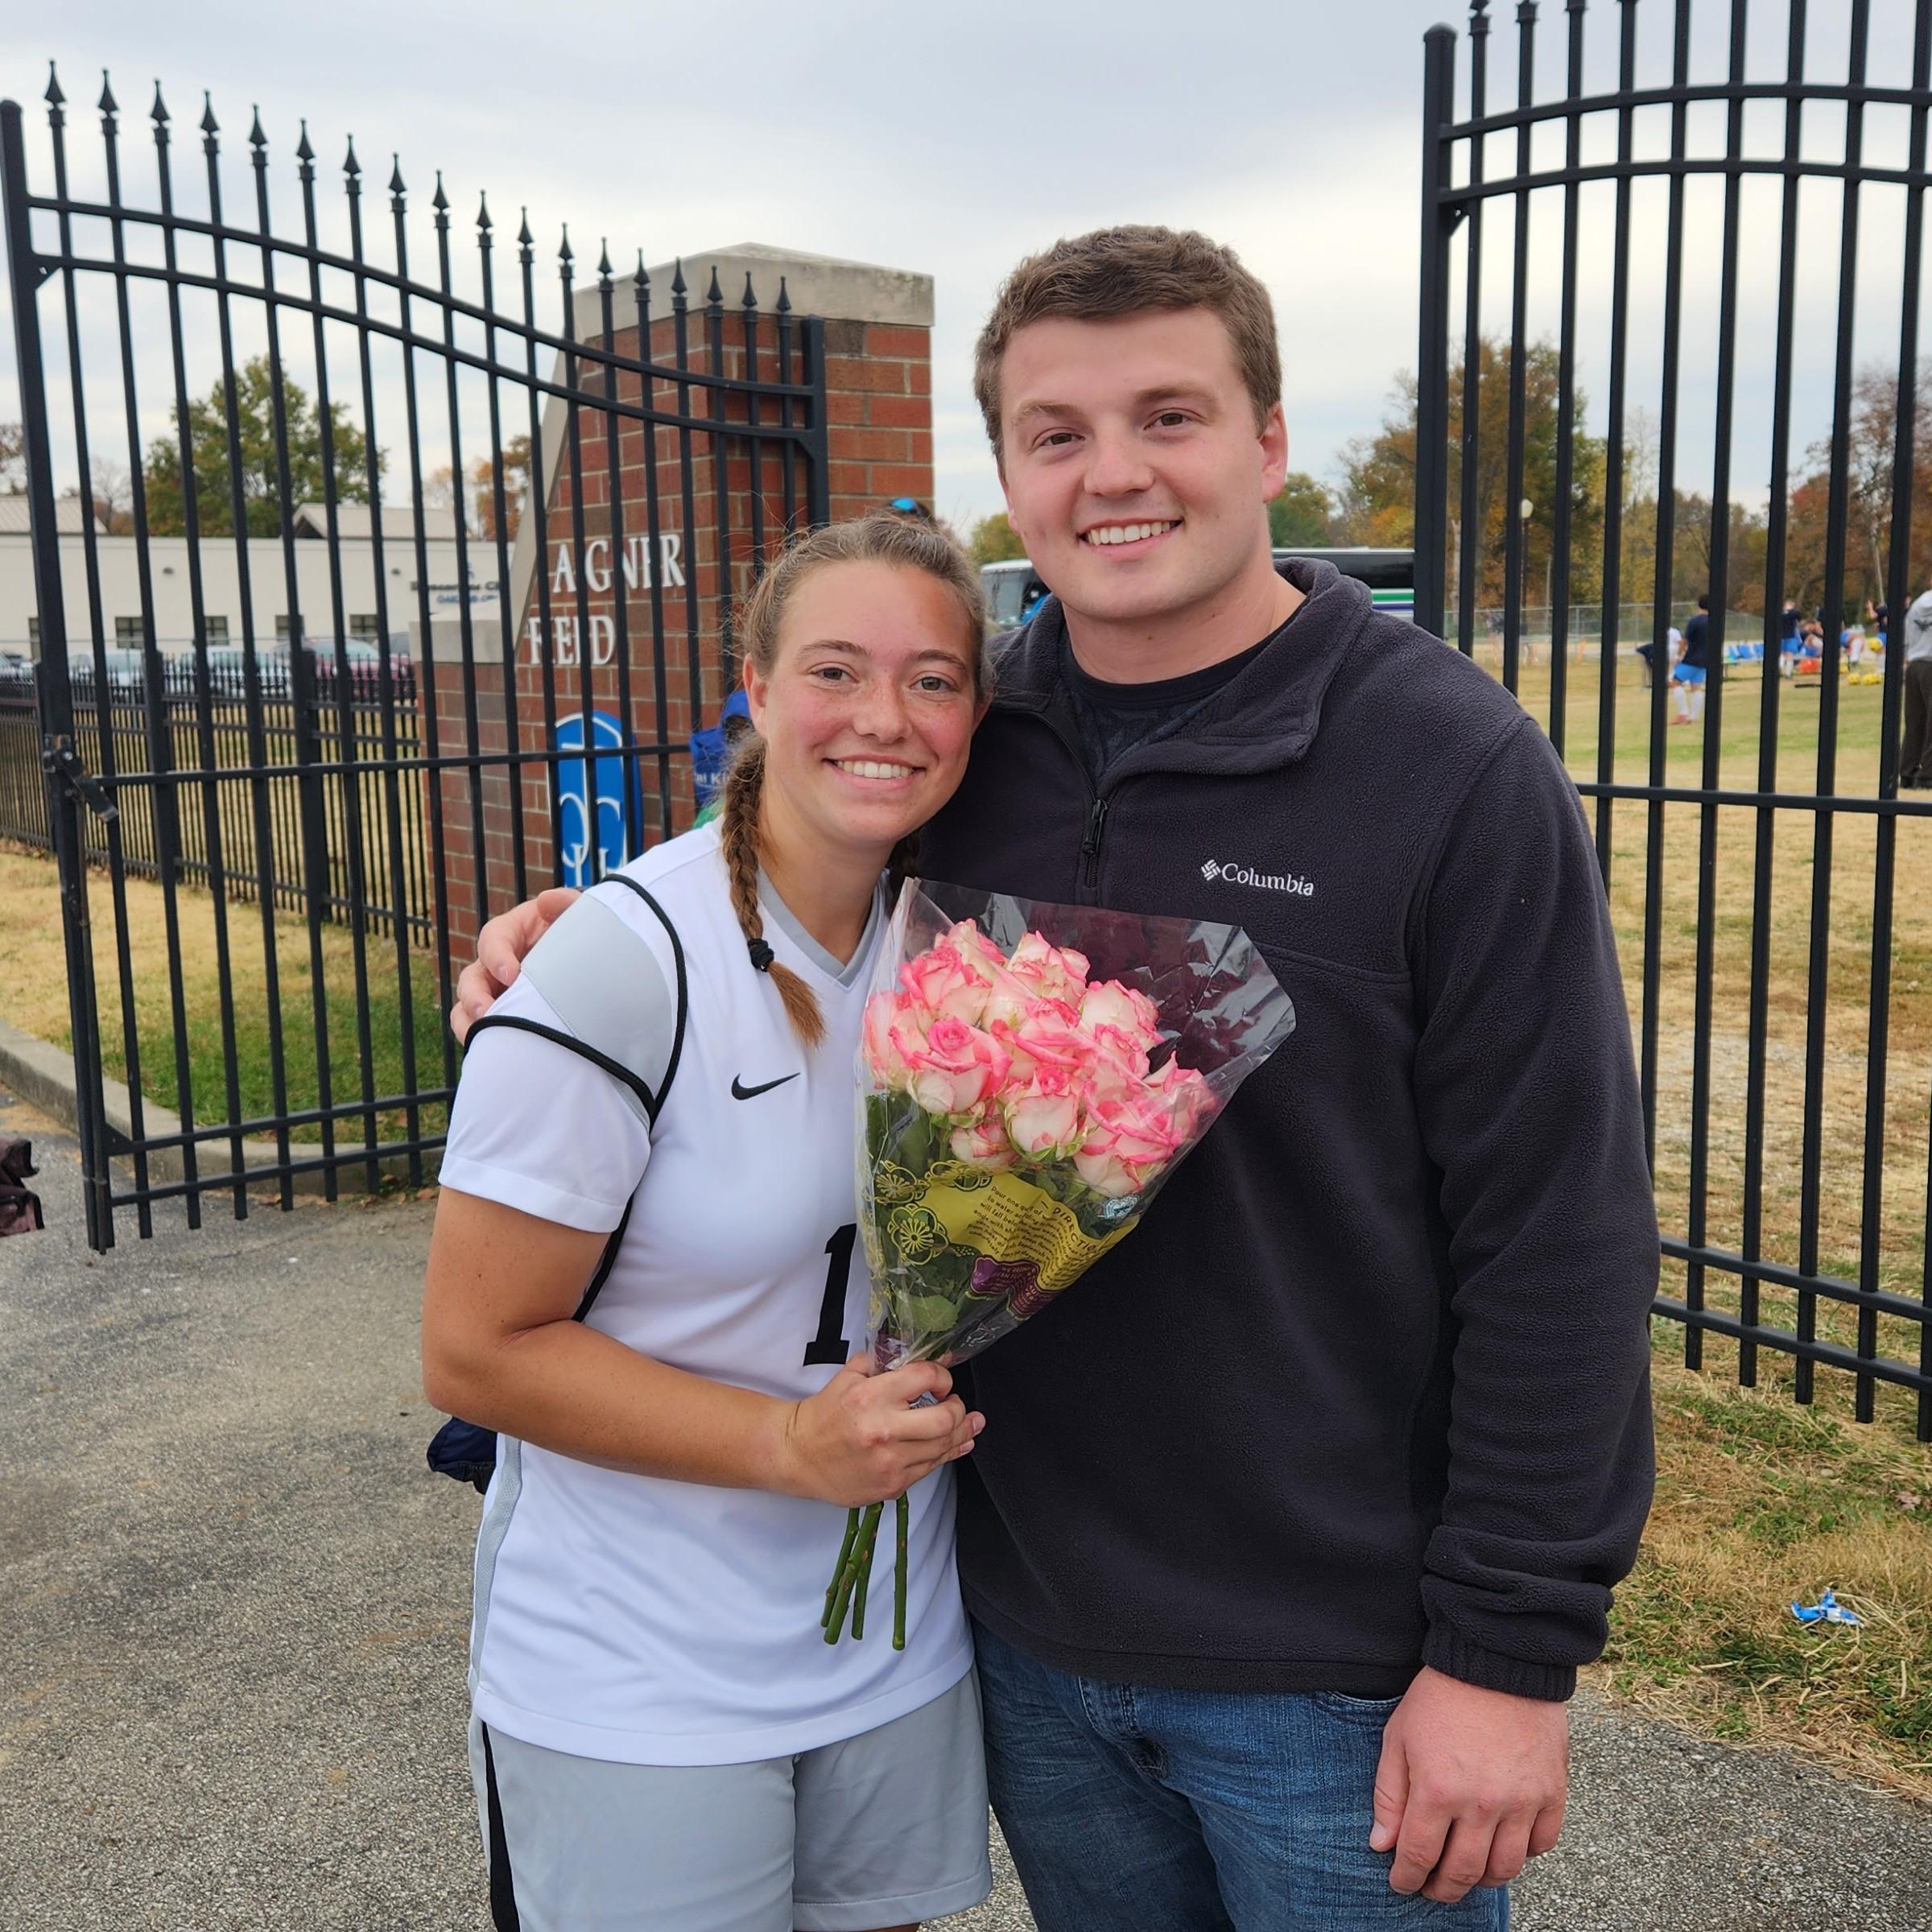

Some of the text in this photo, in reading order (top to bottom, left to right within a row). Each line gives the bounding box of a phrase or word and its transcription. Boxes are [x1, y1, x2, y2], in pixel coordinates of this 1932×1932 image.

[1221, 863, 1315, 896] Columbia
[991, 1186, 1006, 1199] Pour
[1006, 1197, 1019, 1208] one
[980, 1202, 993, 1212] will
[992, 1209, 1004, 1219] fall
[996, 1201, 1014, 1215] water
